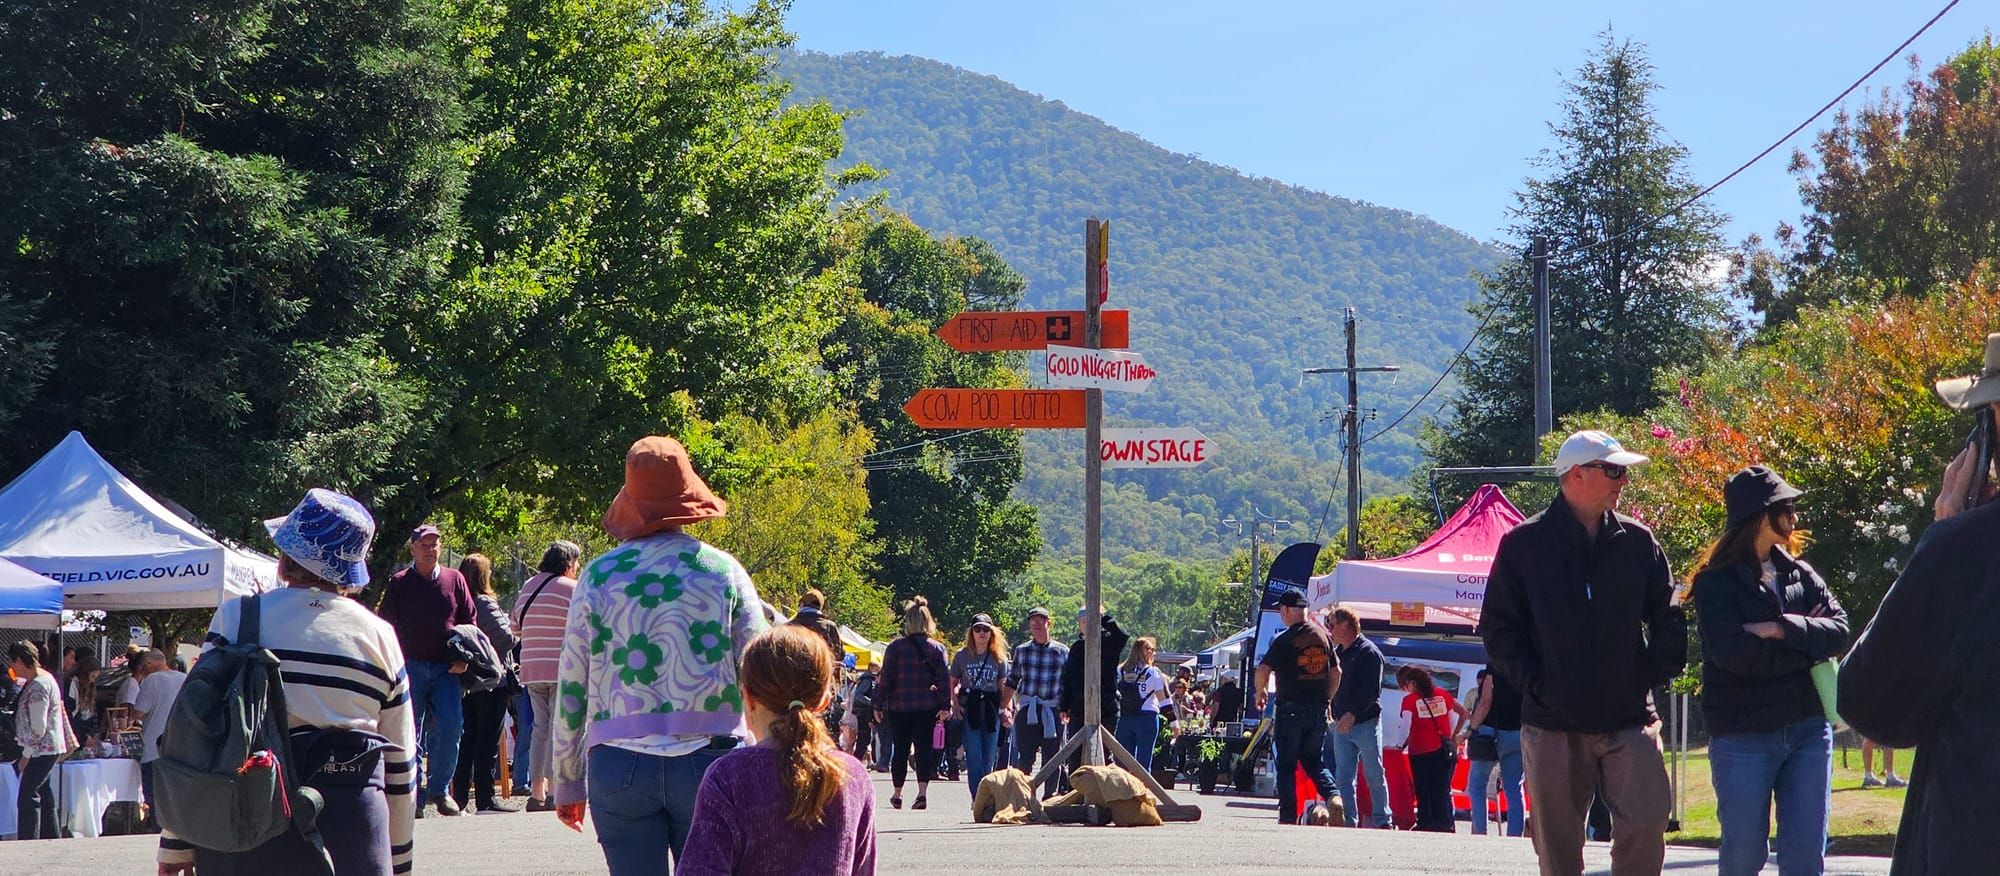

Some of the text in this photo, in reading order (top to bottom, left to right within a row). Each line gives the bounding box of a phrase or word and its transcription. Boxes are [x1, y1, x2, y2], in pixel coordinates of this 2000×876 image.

[959, 318, 1038, 344] FIRST AID
[1048, 353, 1080, 376] GOLD
[1081, 354, 1122, 381] NUGGET
[922, 392, 1061, 422] COW POO LOTTO
[1101, 439, 1206, 463] OWN STAGE
[1462, 554, 1494, 562] Ben
[1456, 574, 1488, 584] Com
[1455, 590, 1484, 600] Man
